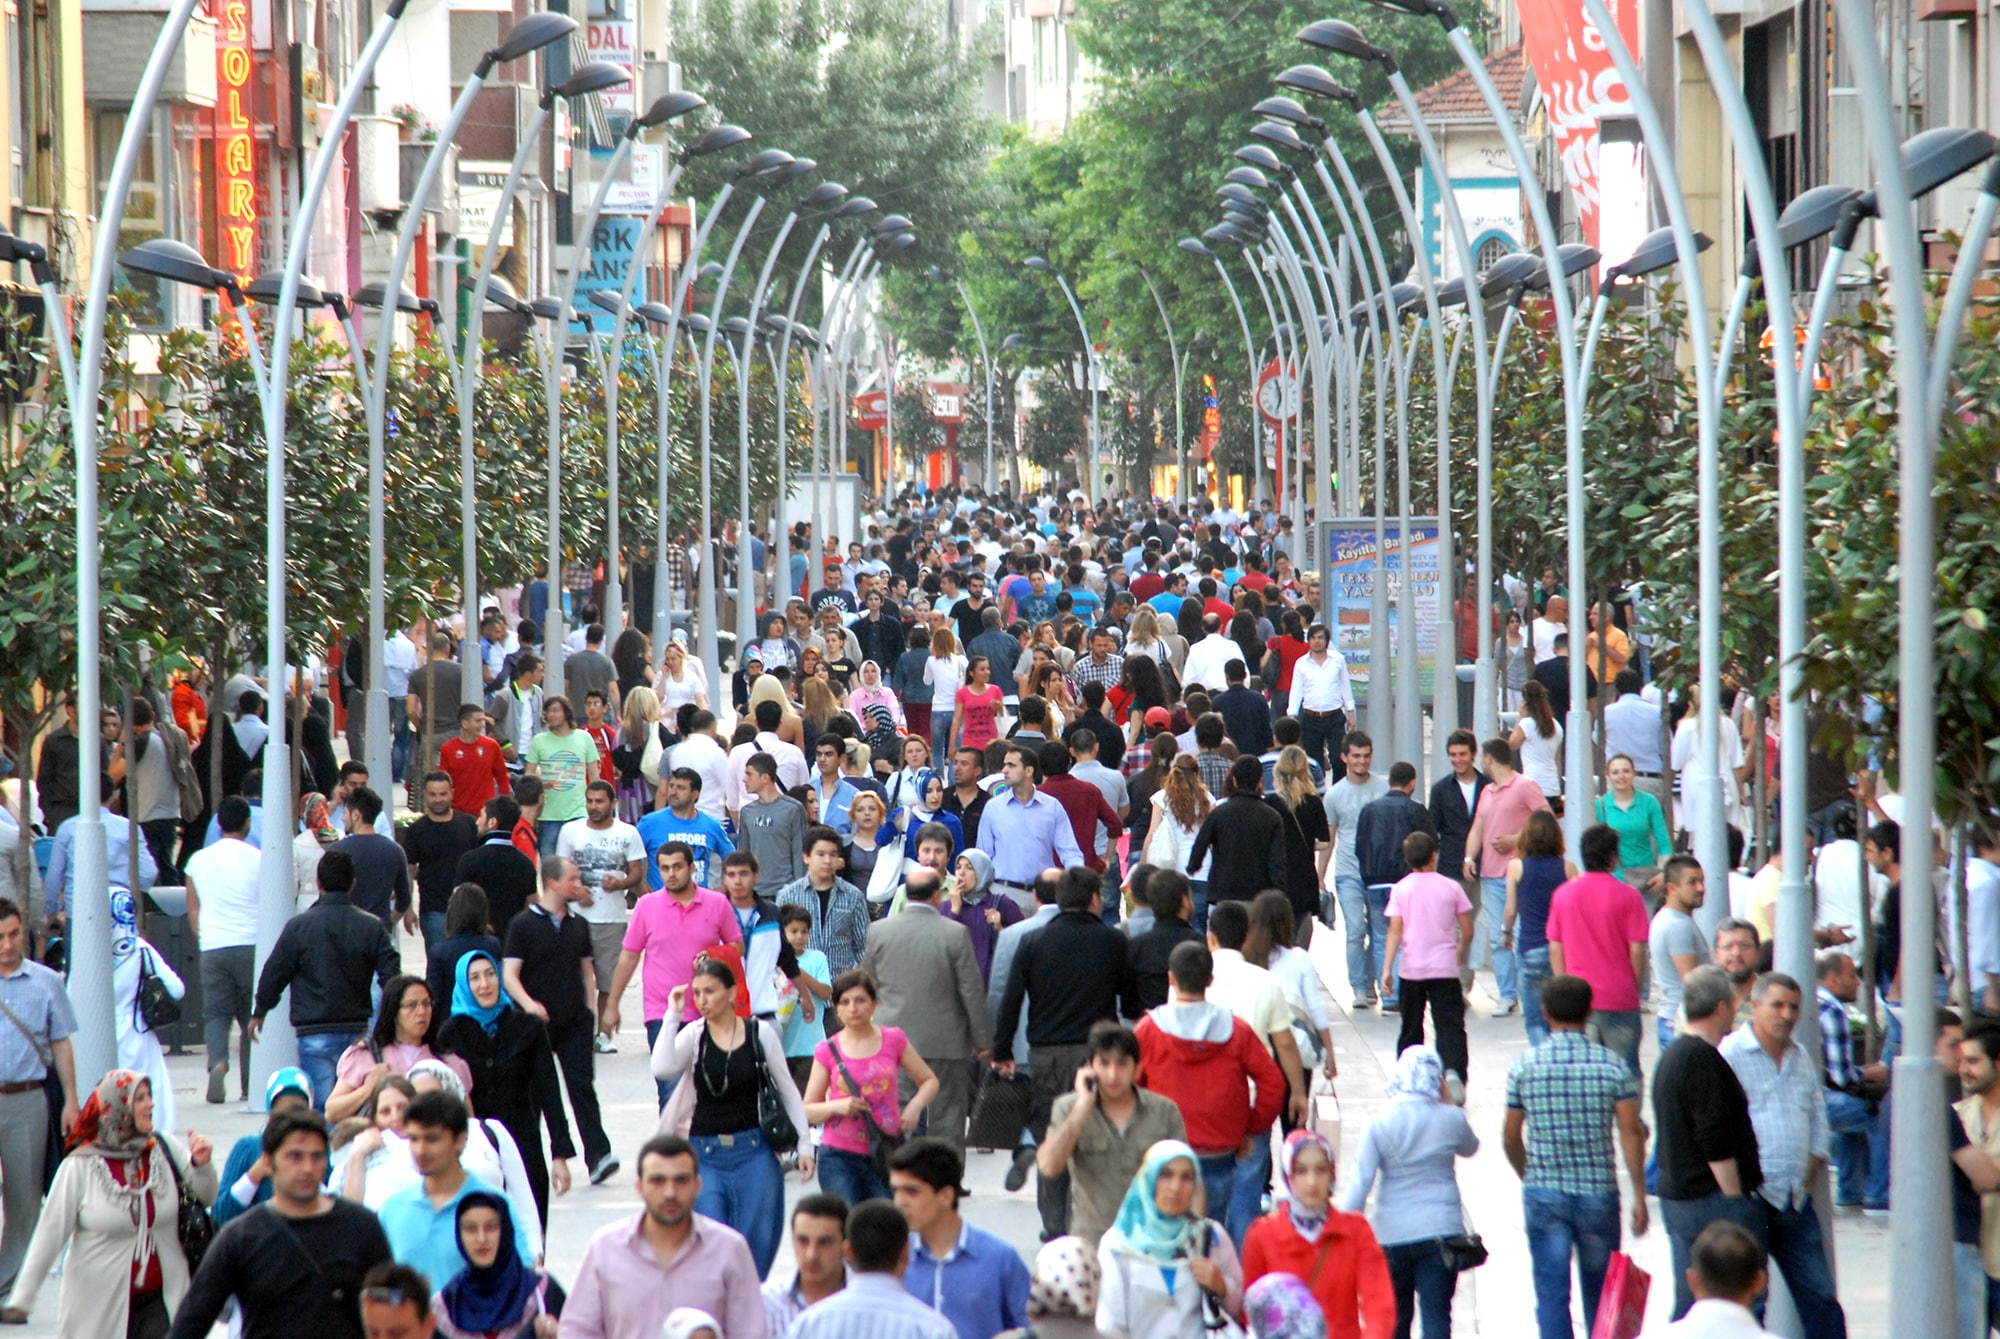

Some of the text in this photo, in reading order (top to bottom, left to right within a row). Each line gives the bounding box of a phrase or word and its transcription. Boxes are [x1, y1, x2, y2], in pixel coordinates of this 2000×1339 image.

[223, 2, 256, 350] SOLARY
[1337, 530, 1425, 561] Kayıtla Baadı
[1343, 585, 1374, 598] YAZ
